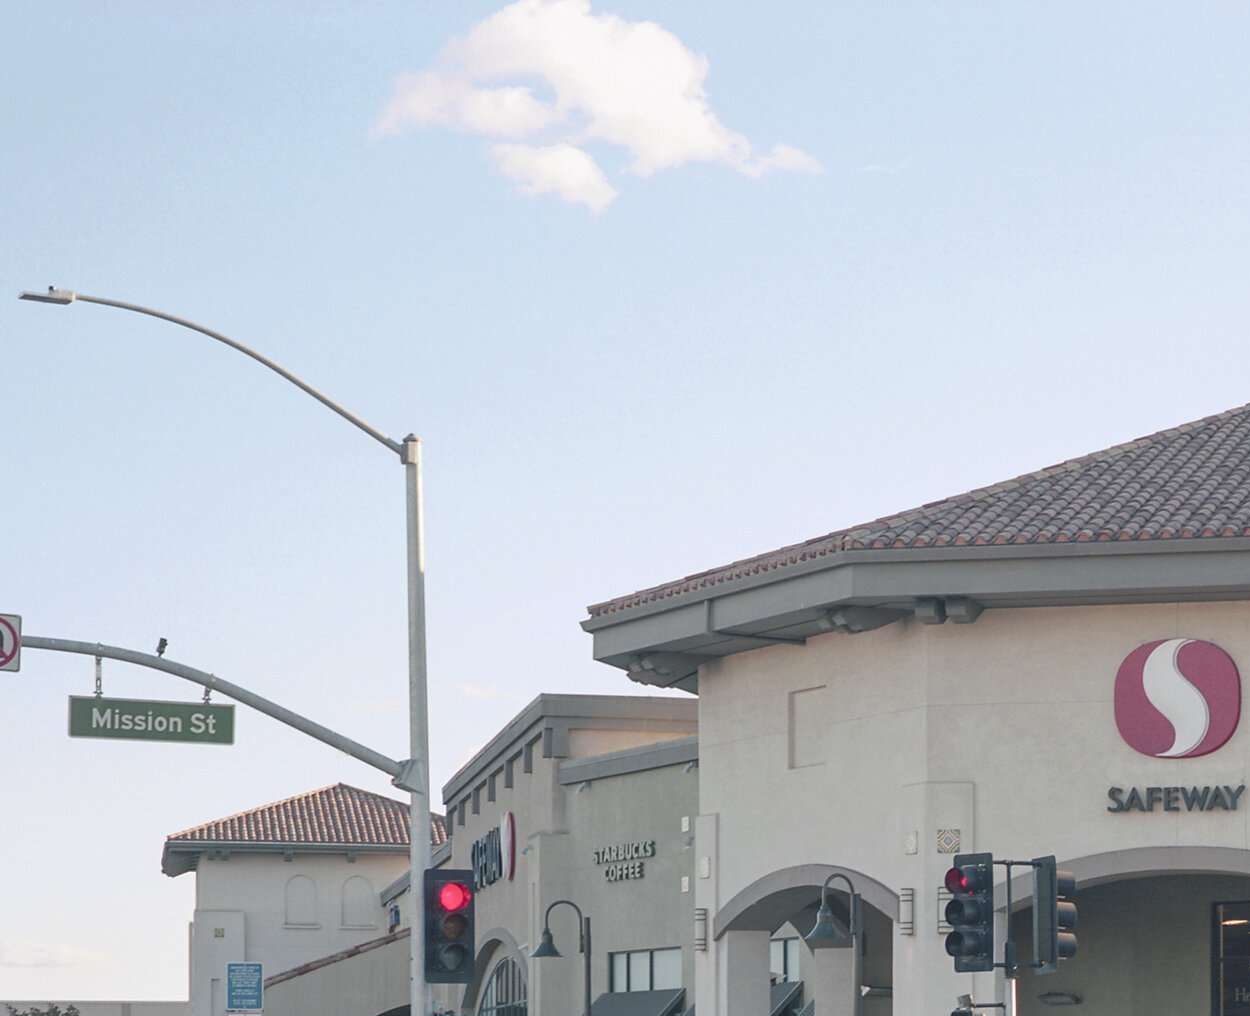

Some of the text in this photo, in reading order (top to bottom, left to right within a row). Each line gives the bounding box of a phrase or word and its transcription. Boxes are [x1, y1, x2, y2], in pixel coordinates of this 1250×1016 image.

[92, 708, 217, 734] Mission St
[1107, 784, 1246, 813] SAFEWAY
[593, 840, 656, 864] STARBUCKS
[604, 862, 645, 882] COFFEE
